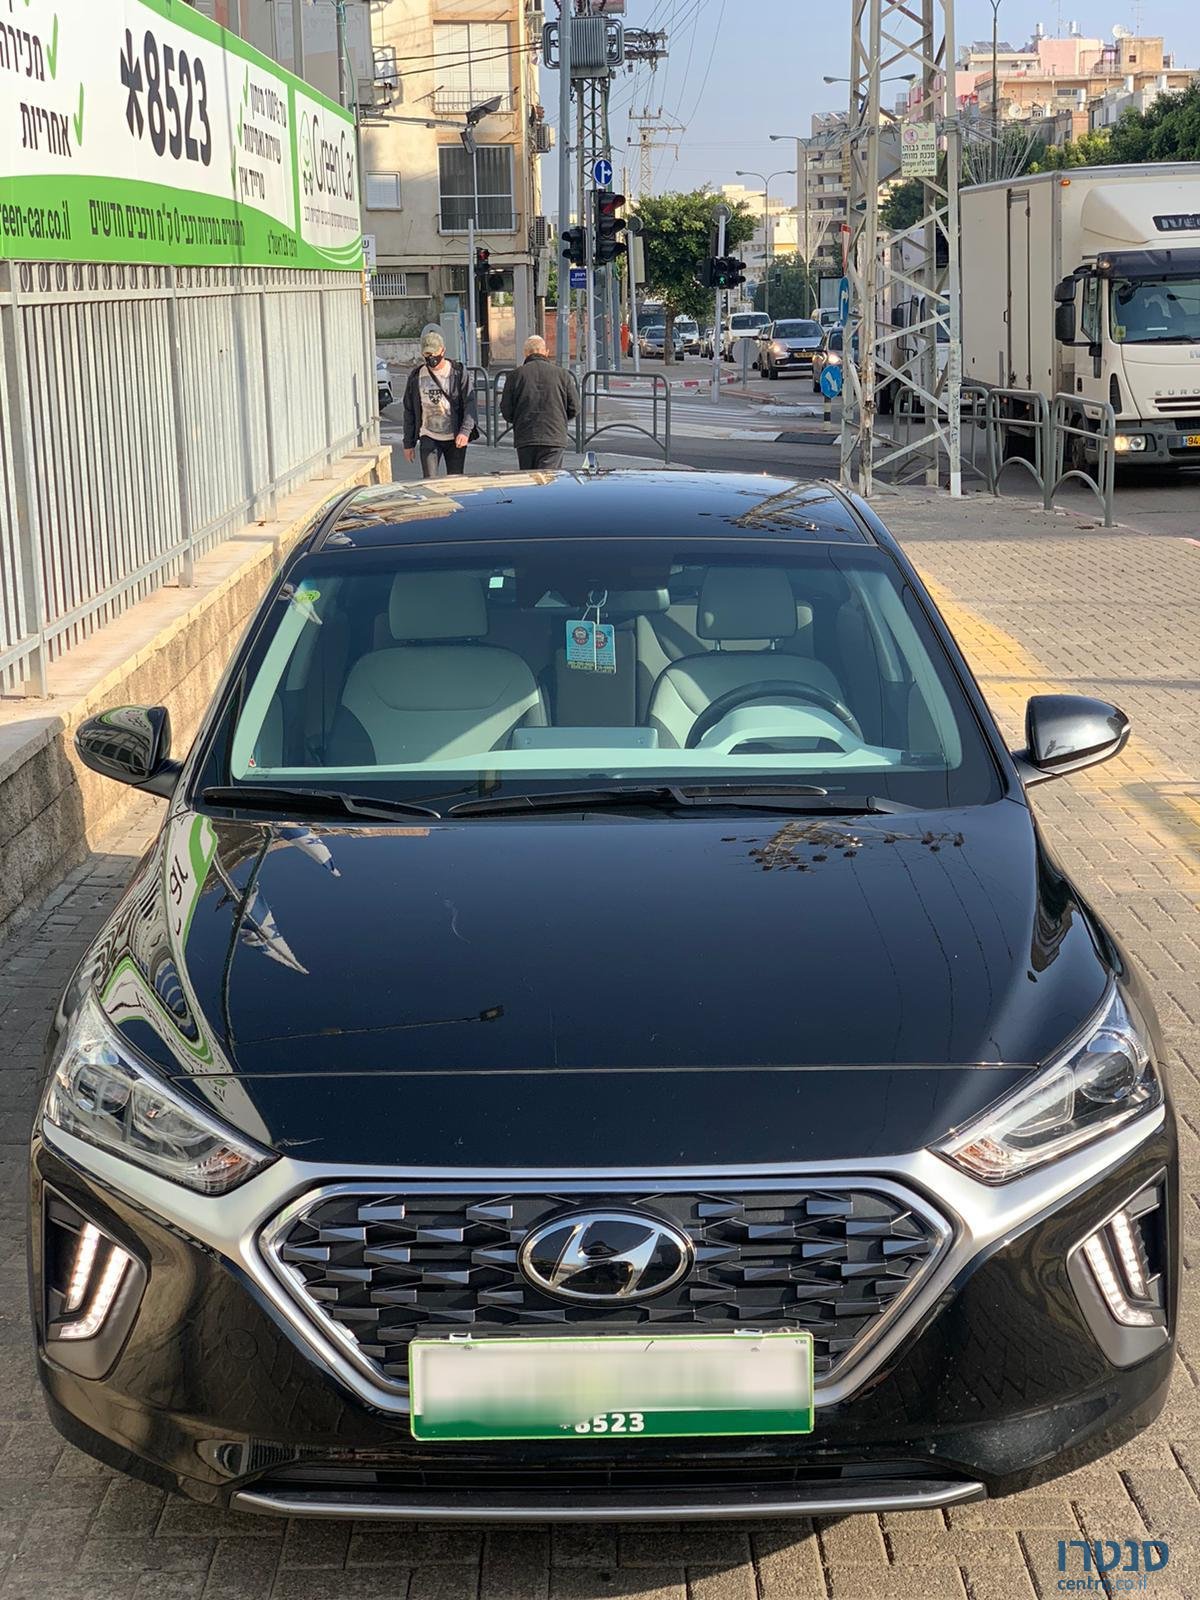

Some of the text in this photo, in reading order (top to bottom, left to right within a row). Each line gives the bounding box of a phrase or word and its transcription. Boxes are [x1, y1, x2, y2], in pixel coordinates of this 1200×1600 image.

[20, 102, 72, 157] אחריות
[312, 114, 354, 201] Green Car
[89, 199, 125, 238] חדשים
[125, 205, 156, 241] ורכבים
[1161, 217, 1200, 229] IVE
